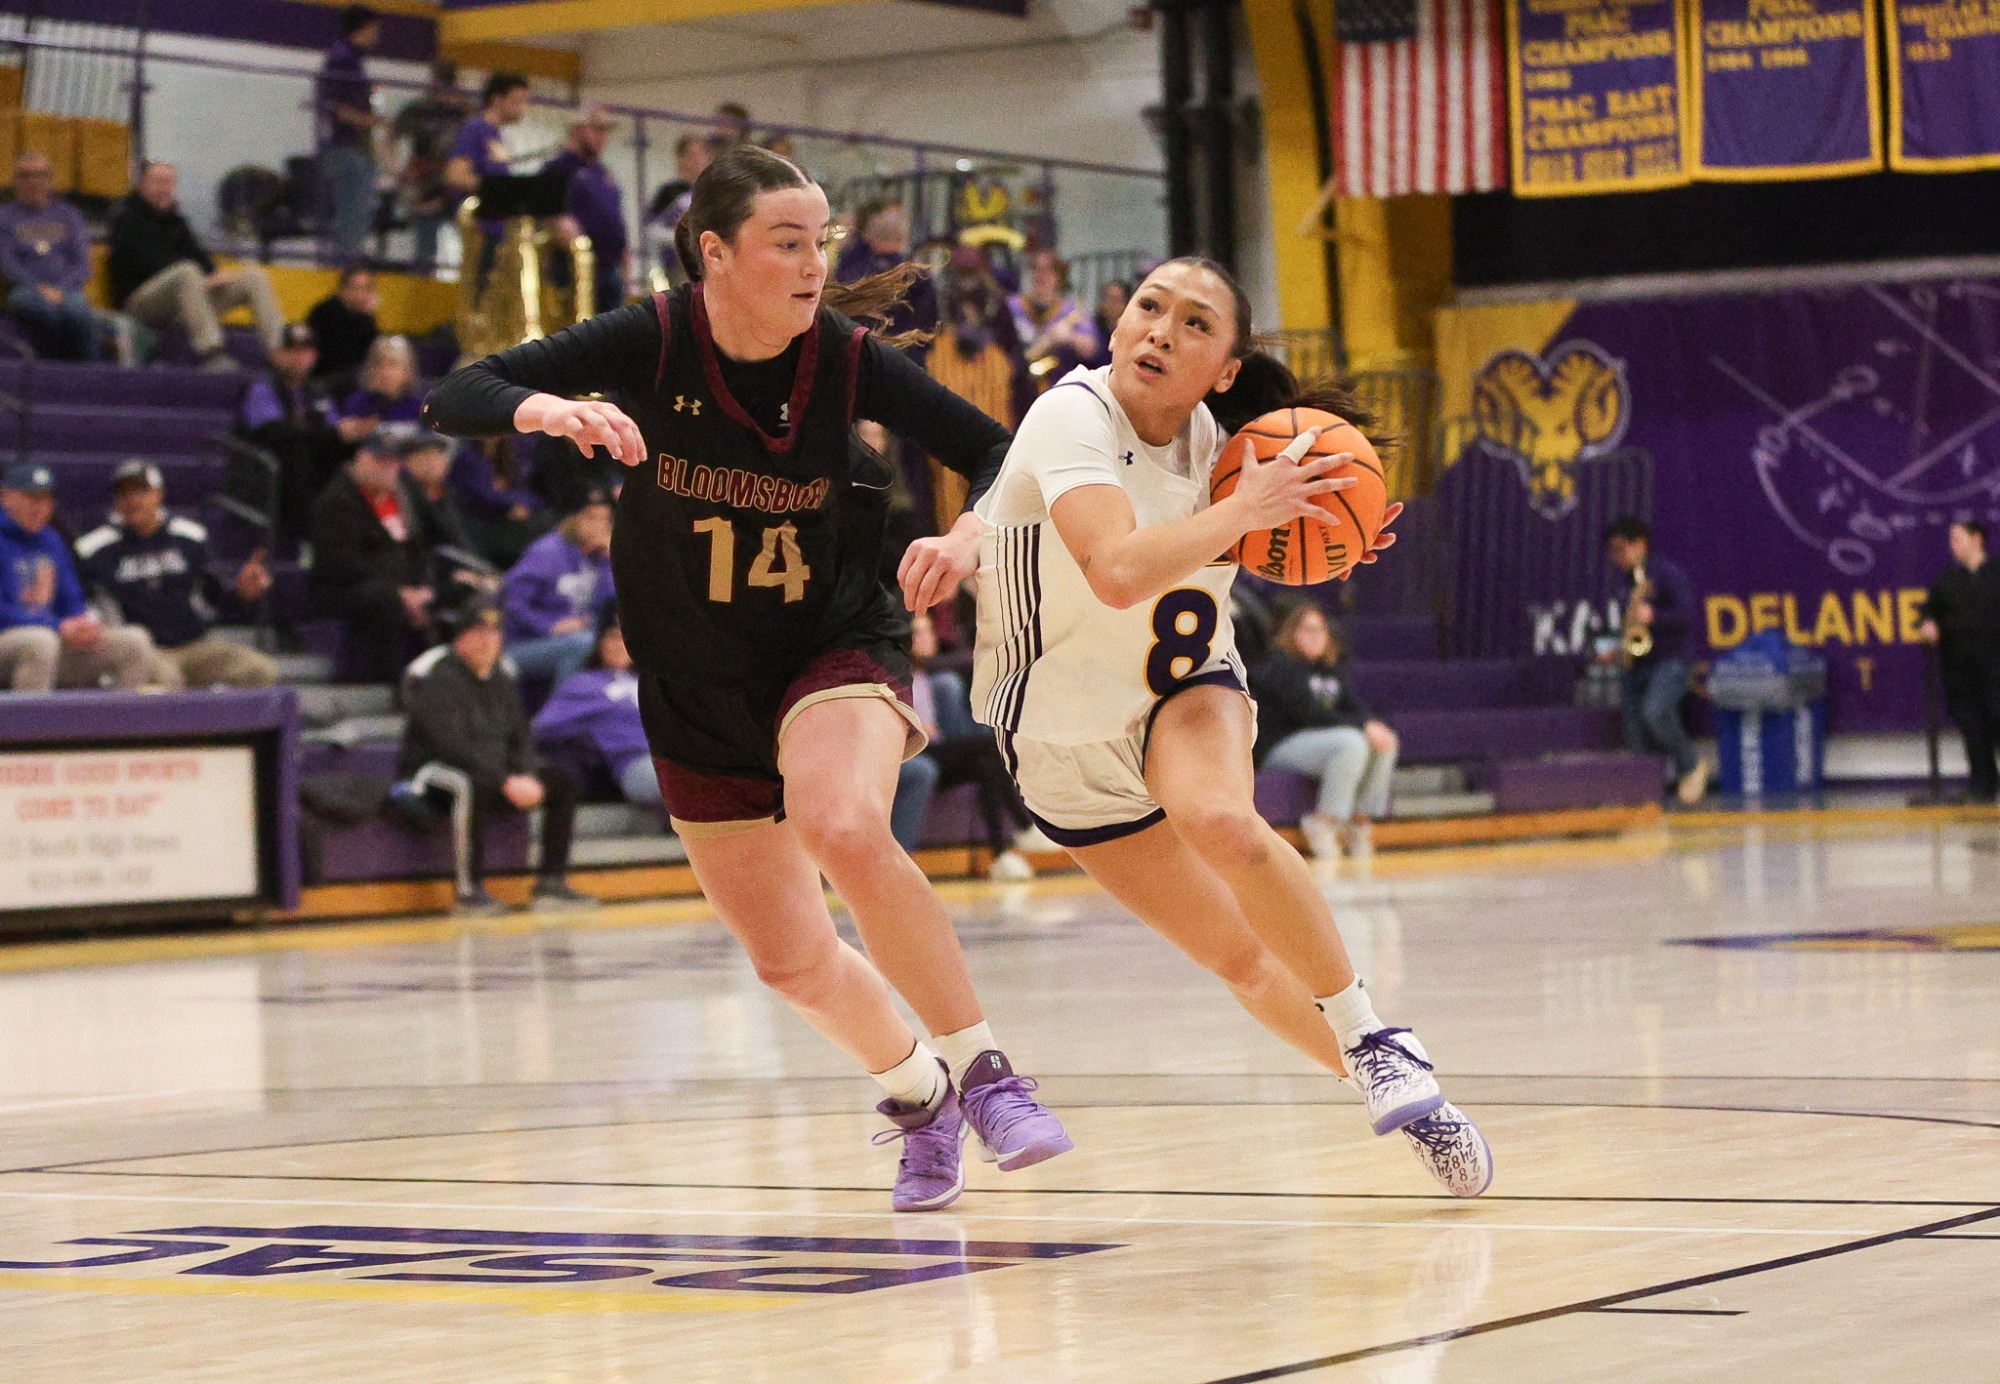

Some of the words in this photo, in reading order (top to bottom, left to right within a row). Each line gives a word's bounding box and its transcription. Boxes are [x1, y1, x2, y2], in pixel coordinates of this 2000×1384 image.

[1523, 29, 1672, 67] CHAMPIONS
[1705, 10, 1864, 47] CHAMPIONS
[1528, 94, 1595, 124] PSAC
[1528, 113, 1675, 150] CHAMPIONS
[657, 453, 832, 514] BLOOMSBUR
[693, 516, 811, 603] 14
[1143, 585, 1220, 698] 8
[1705, 588, 1930, 649] DELANE
